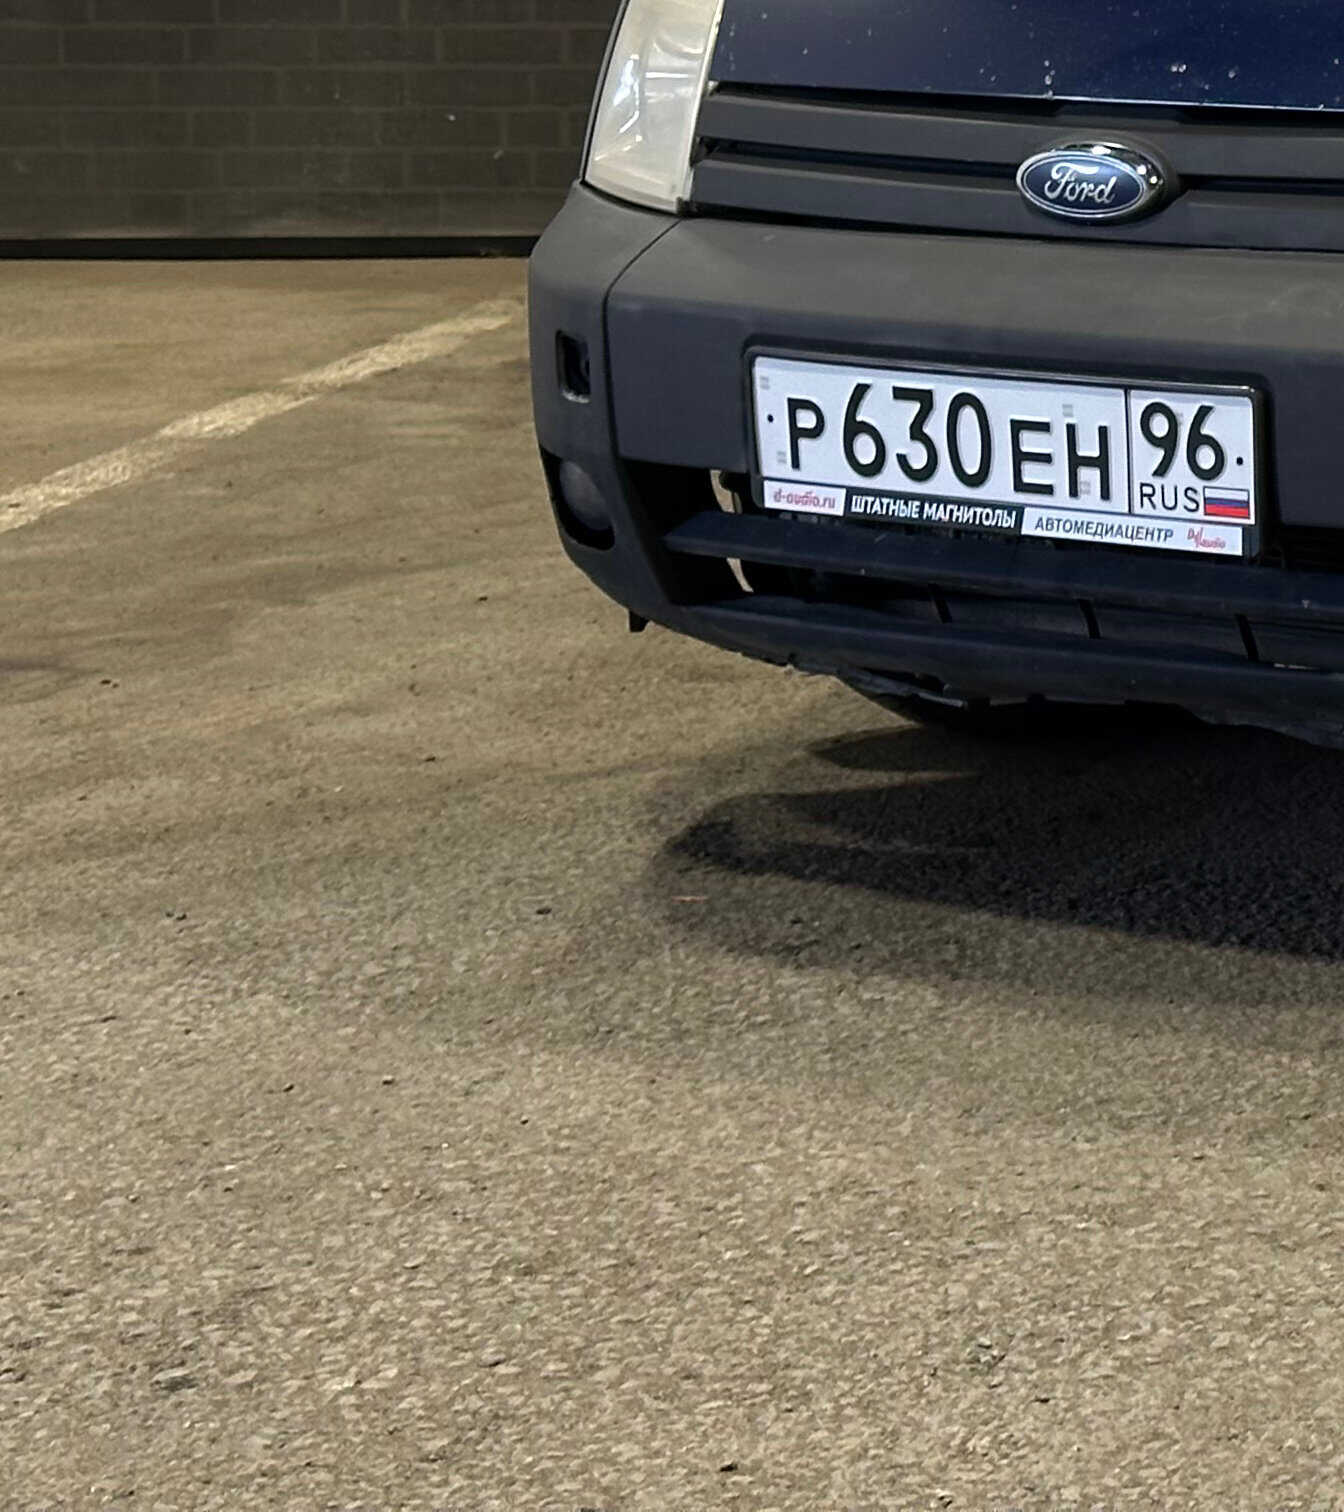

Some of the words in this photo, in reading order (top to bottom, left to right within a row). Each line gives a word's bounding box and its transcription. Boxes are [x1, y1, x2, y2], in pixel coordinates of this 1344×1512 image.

[1043, 162, 1118, 204] Ford
[1140, 402, 1226, 481] 96
[850, 494, 919, 519] ШТАТНЫЕ
[922, 500, 1017, 529] МАГНИТОЛЫ
[1140, 482, 1200, 513] RUS
[1034, 516, 1174, 543] АВТОМЕДИАЦЕНТР
